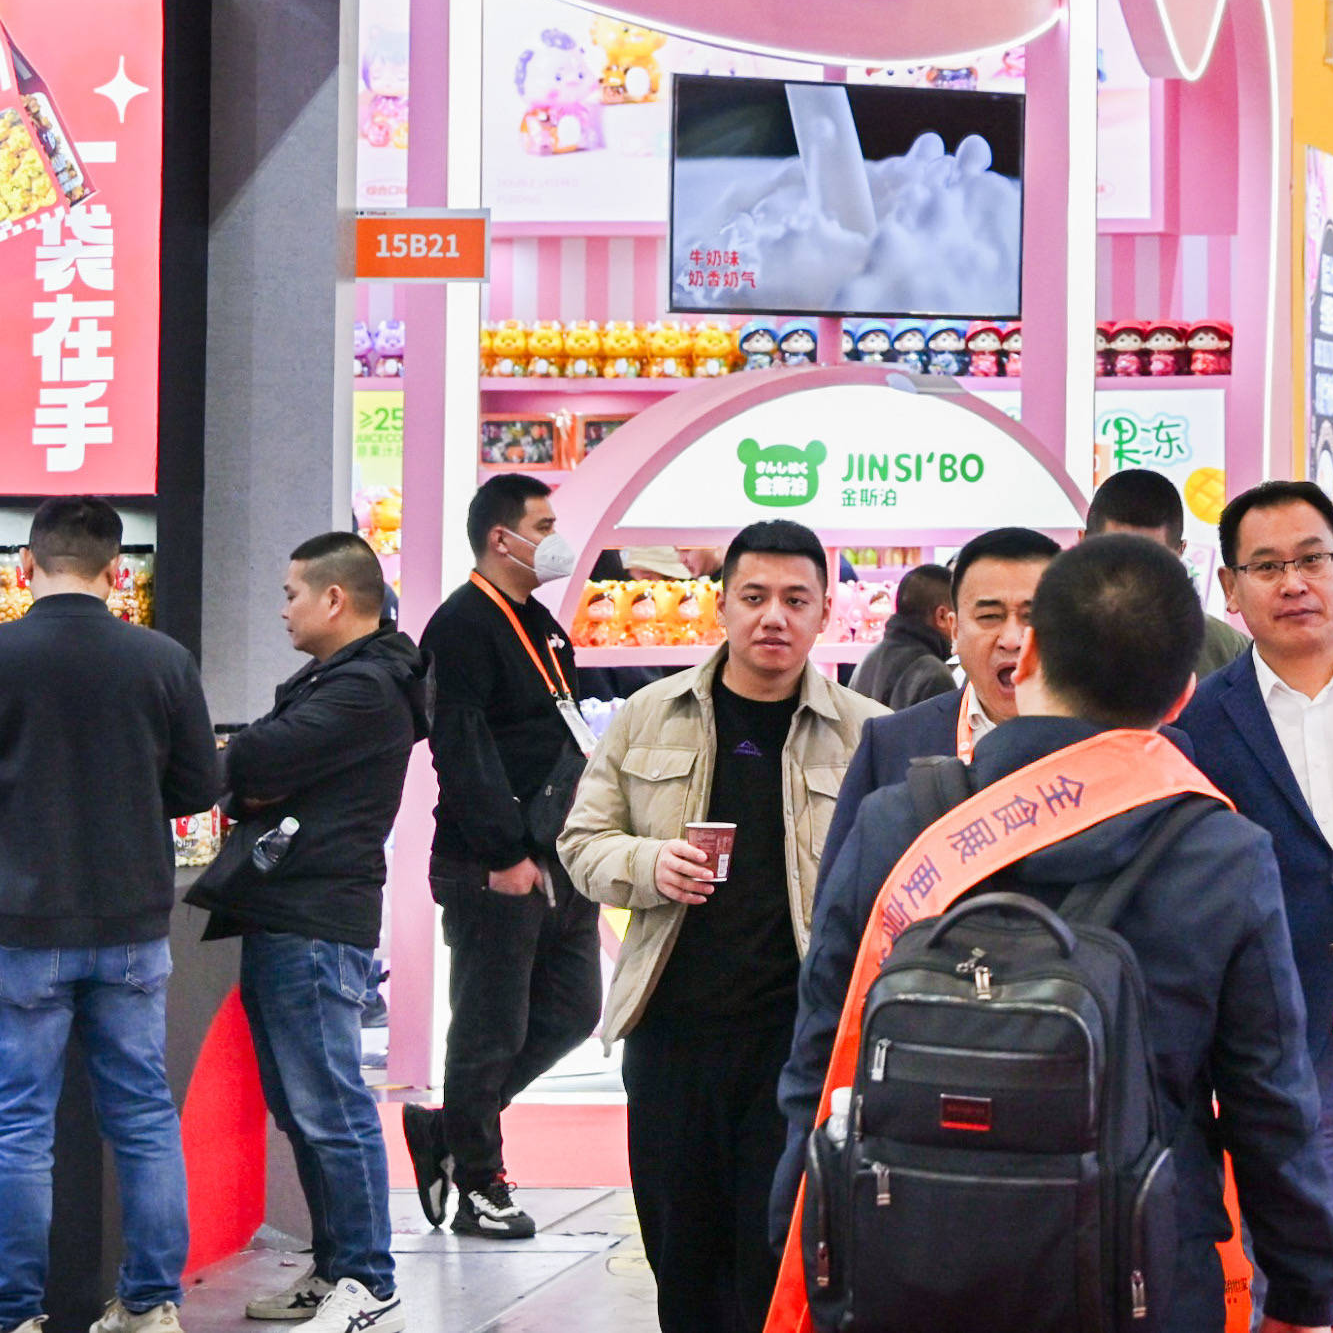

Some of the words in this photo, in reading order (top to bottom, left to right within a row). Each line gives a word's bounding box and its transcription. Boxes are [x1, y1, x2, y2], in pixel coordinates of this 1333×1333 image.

[375, 233, 460, 258] 15B21
[689, 249, 740, 266] 牛奶味
[688, 270, 757, 290] 奶香奶气
[841, 488, 897, 507] 金斯泊
[945, 774, 1085, 865] 全食展
